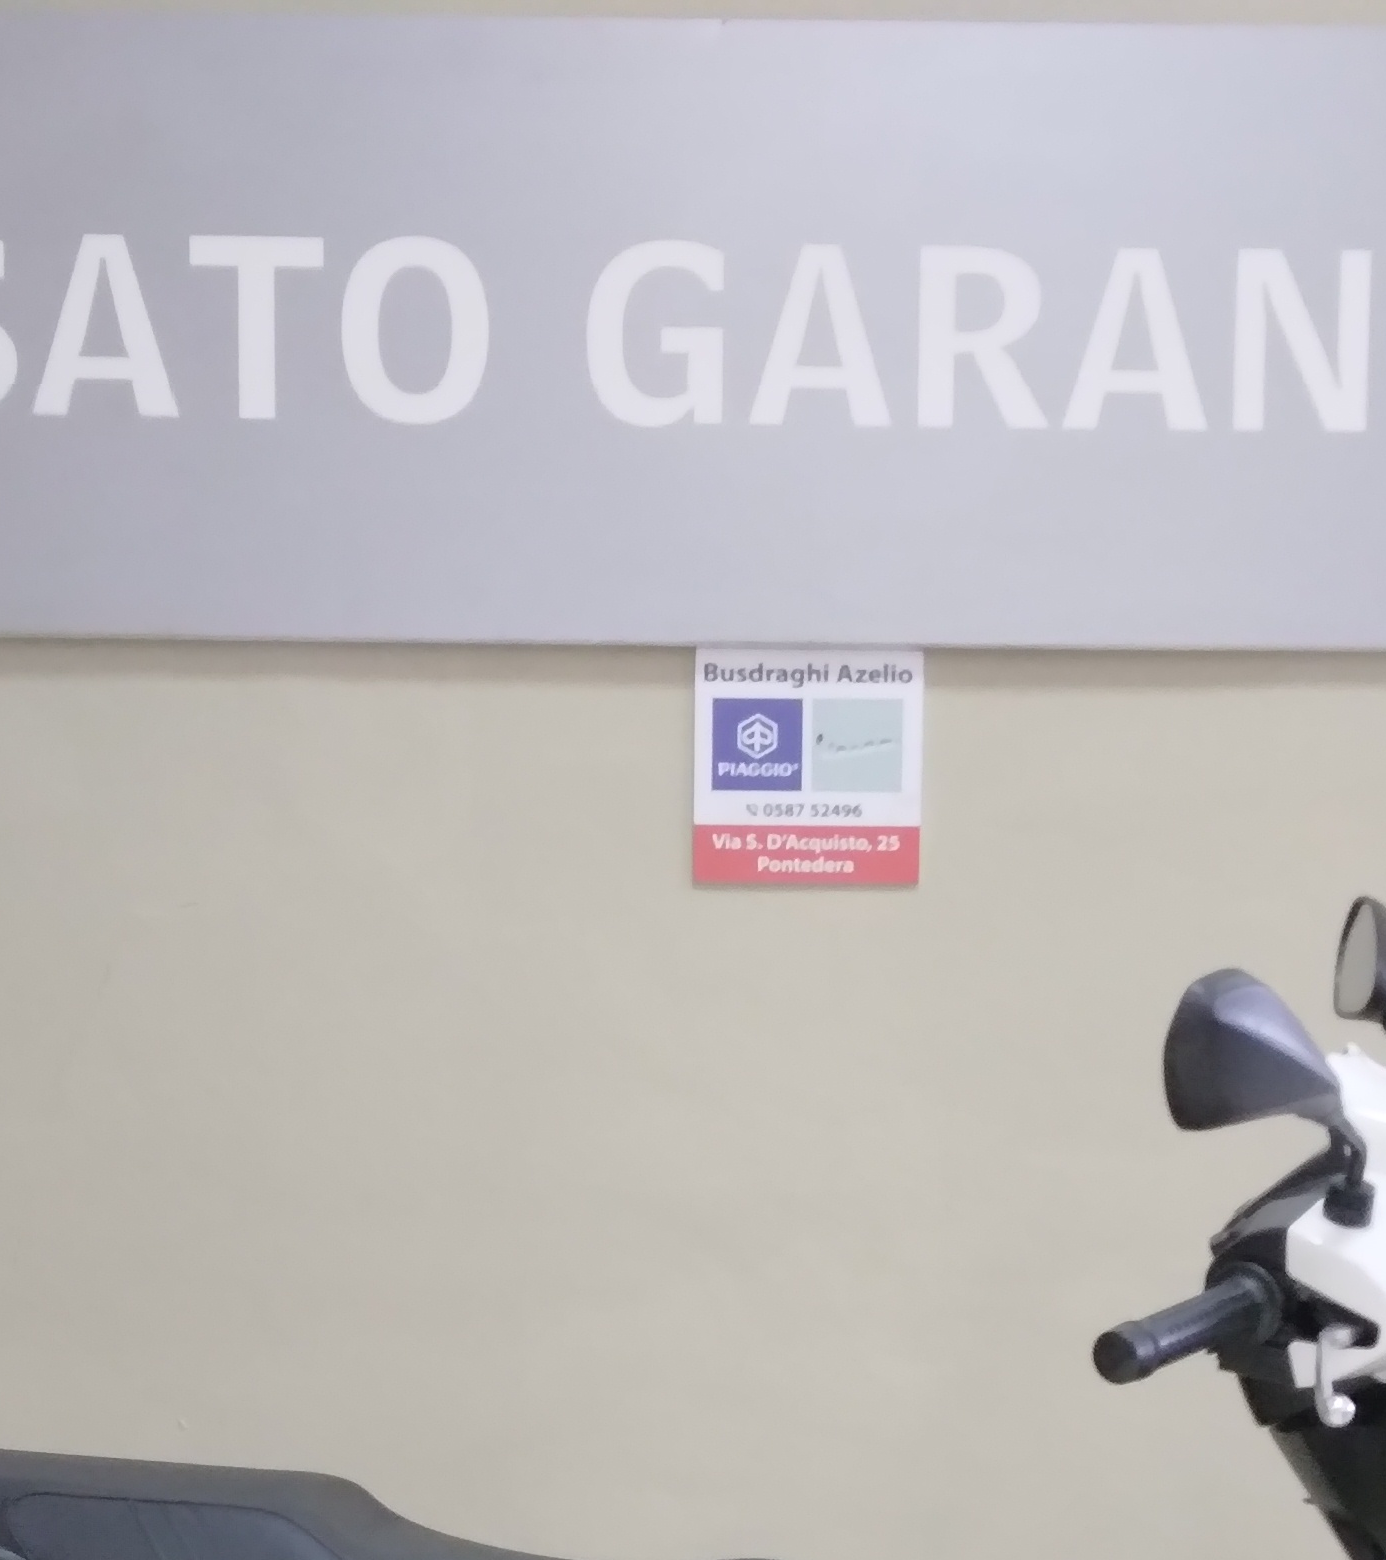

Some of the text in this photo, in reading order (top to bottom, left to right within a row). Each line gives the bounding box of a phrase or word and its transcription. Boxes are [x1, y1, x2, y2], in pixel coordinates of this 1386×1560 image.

[703, 663, 913, 688] Busdraghi Azelio
[717, 762, 795, 778] PIAGGIO
[762, 803, 863, 817] 0587 52496
[712, 834, 742, 850] Via
[745, 834, 764, 850] S.
[876, 835, 901, 851] 25
[756, 856, 855, 874] Pontedera
